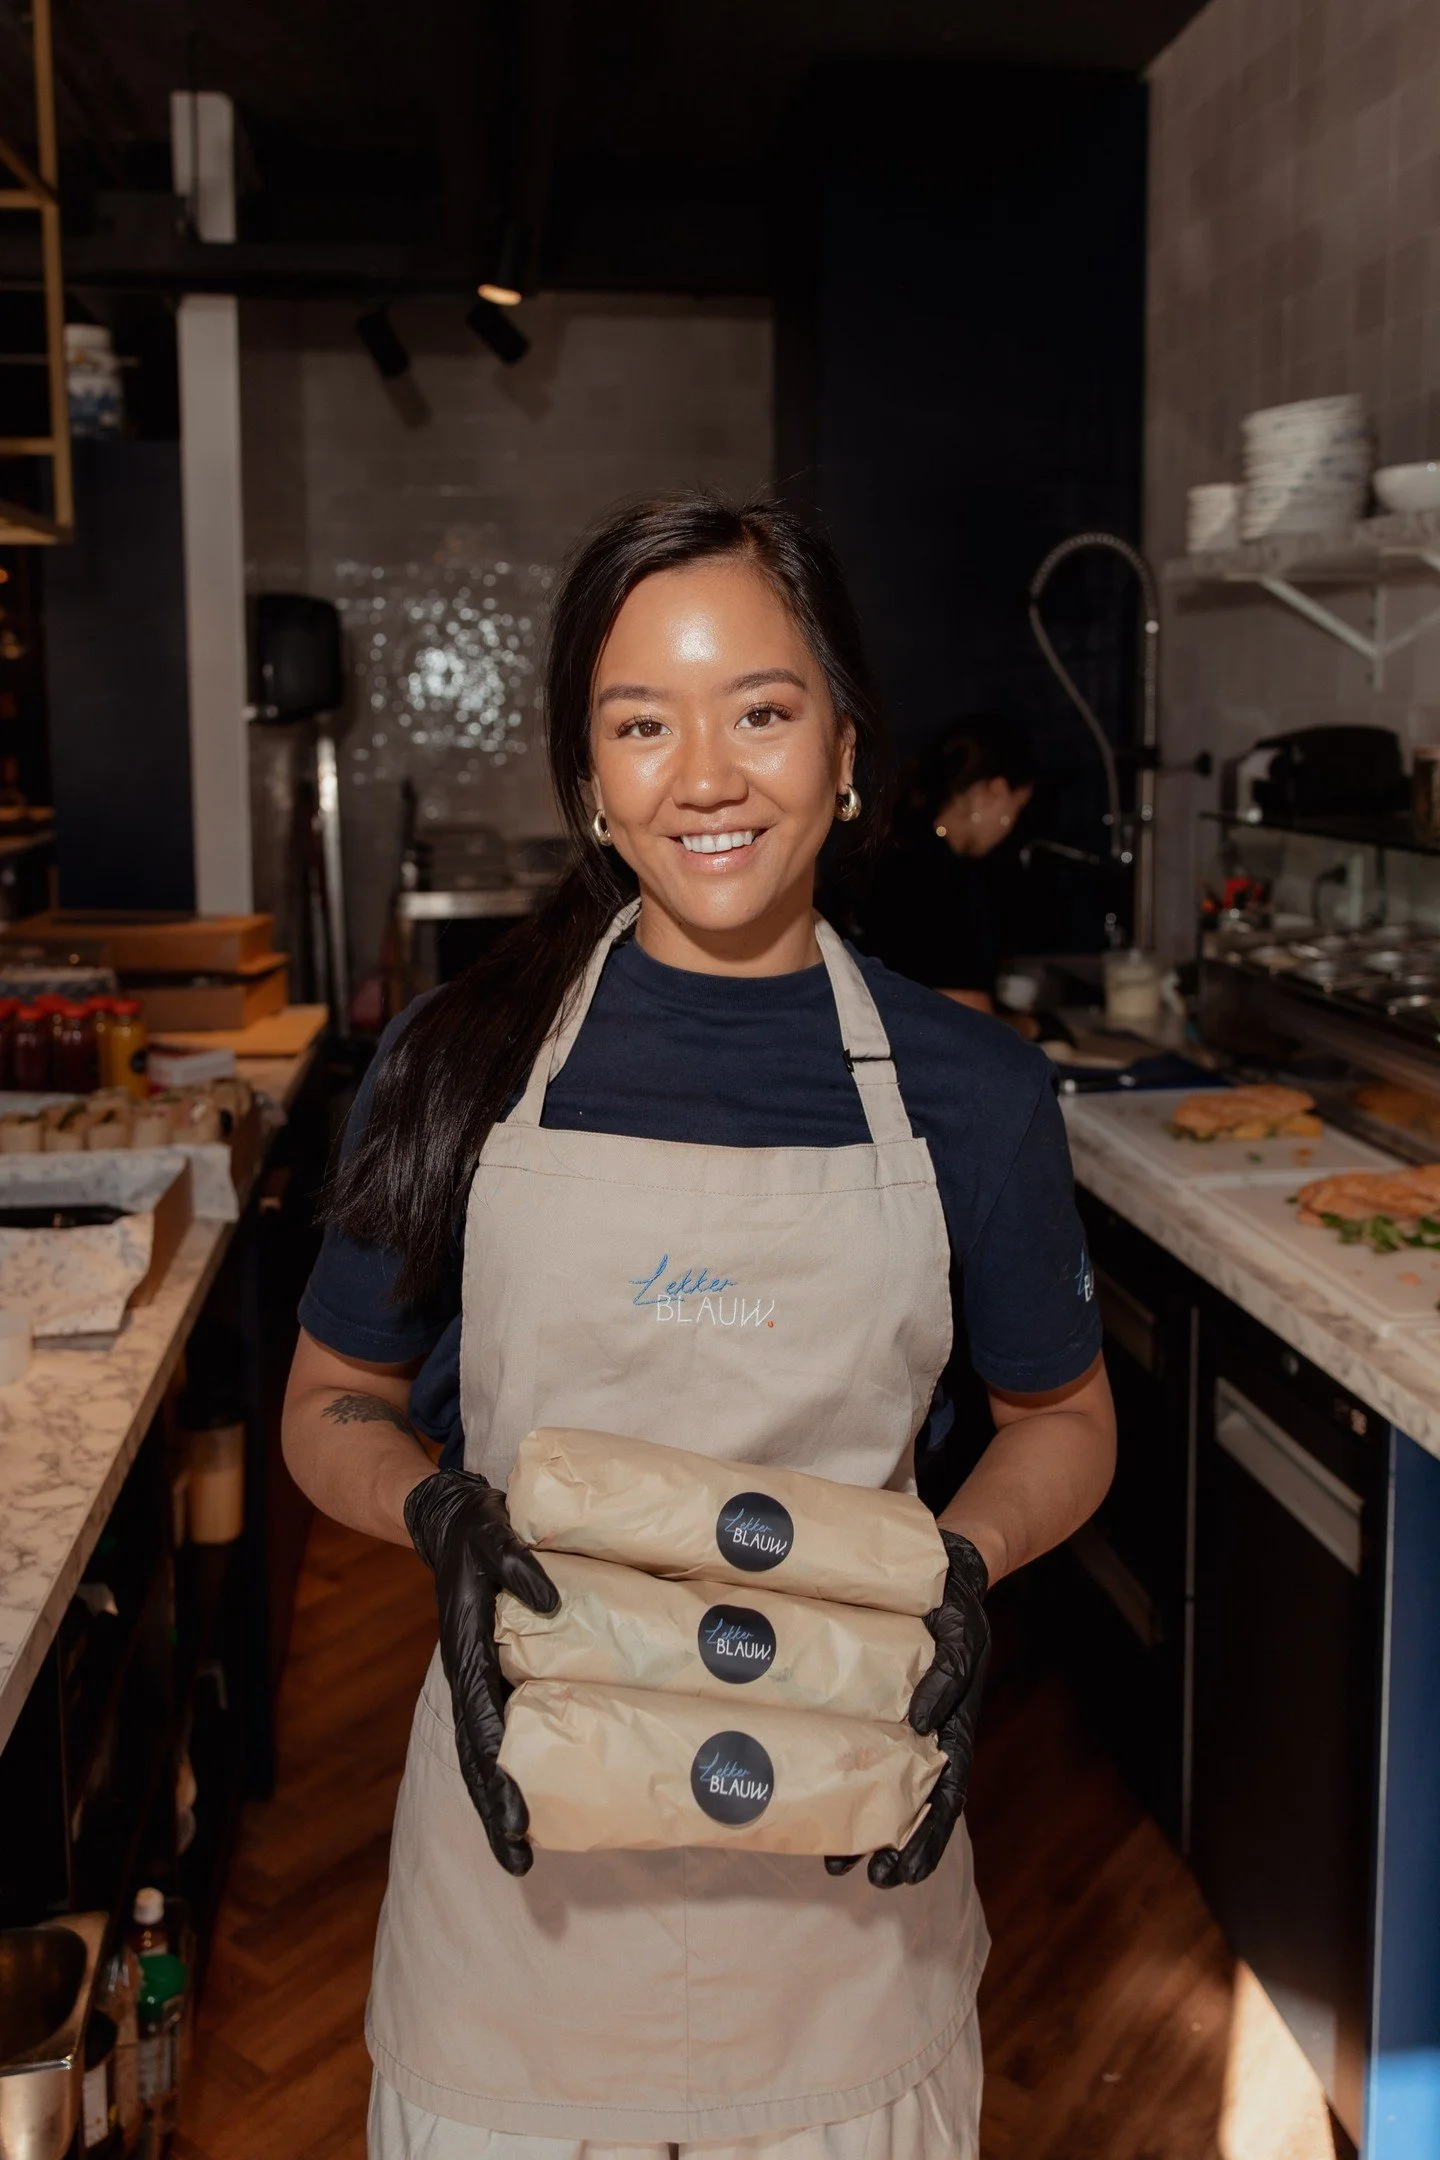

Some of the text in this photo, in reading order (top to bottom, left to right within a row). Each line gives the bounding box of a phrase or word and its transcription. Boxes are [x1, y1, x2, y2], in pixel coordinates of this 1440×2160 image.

[629, 1253, 738, 1306] Lekker
[656, 1294, 775, 1328] BLAUW.
[724, 1508, 772, 1533] Lekker
[733, 1527, 787, 1556] BLAUW.
[704, 1618, 754, 1644] Lekker
[716, 1638, 771, 1660] BLAUW.
[699, 1752, 751, 1781] Lekker
[709, 1775, 769, 1801] BLAUW.
